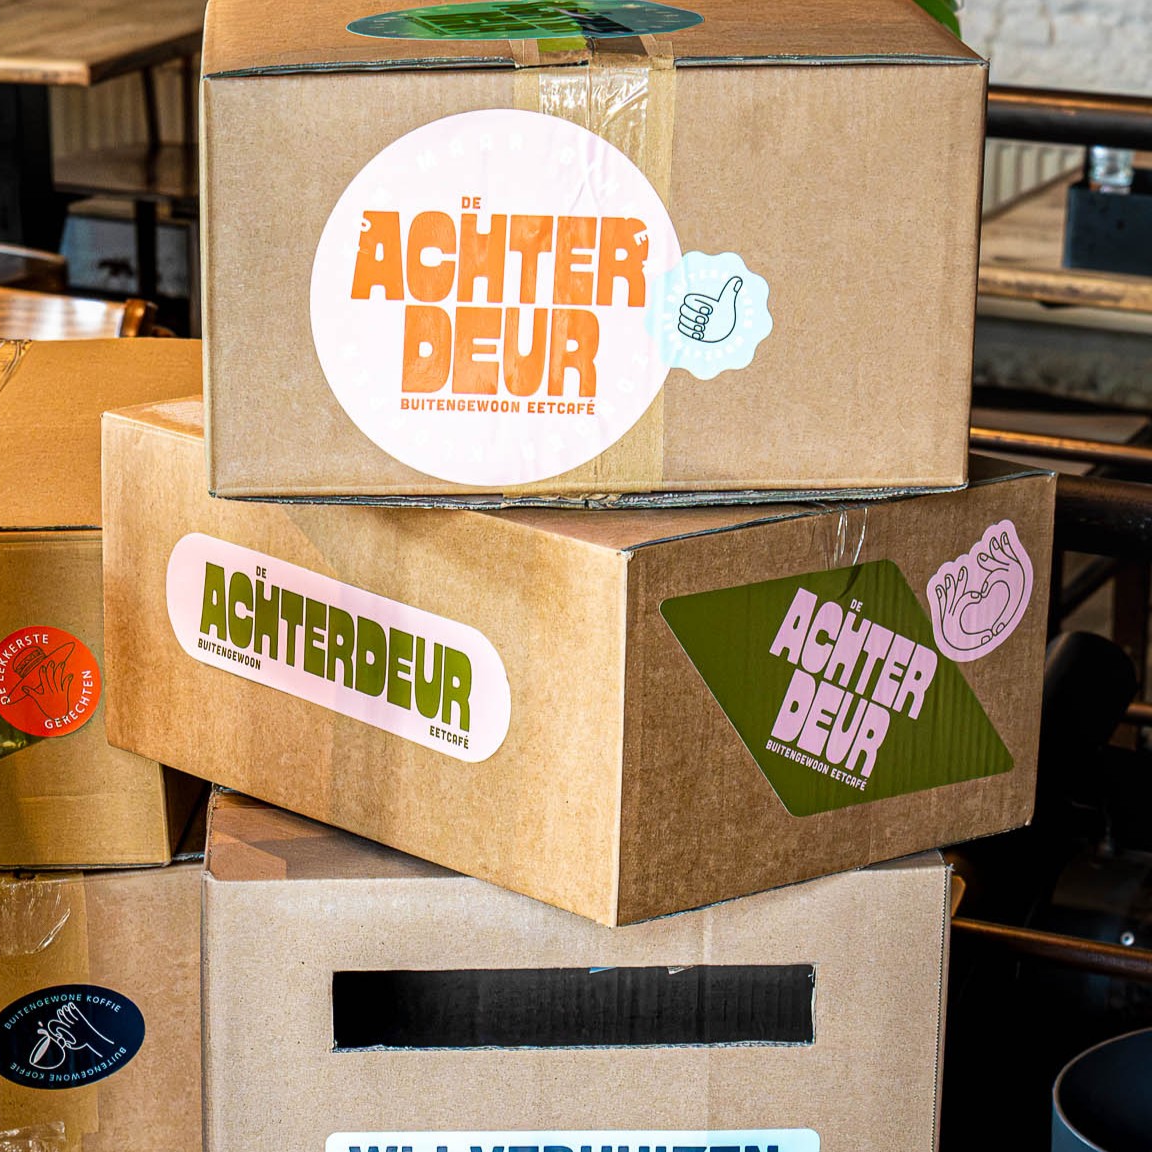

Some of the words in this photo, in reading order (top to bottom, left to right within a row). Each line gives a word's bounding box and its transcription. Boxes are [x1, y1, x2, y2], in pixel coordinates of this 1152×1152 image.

[461, 197, 482, 210] DE
[351, 211, 649, 307] ACHTER
[402, 305, 600, 398] DEUR
[400, 398, 520, 413] BUITENGEWOON
[527, 399, 595, 415] EETCAFÉ
[256, 565, 267, 579] DE
[850, 598, 863, 612] DE
[198, 637, 261, 670] BUITENGEWOON
[200, 562, 472, 732] ACHTERDEUR
[769, 587, 938, 720] ACHTER
[44, 670, 93, 729] GERECHTEN
[429, 725, 469, 749] EETCAFÉ
[771, 668, 890, 778] DEUR
[765, 739, 829, 774] BUITENGEWOON
[831, 768, 867, 791] EETCAFÉ
[4, 993, 82, 1030] BUITENGEWONE
[86, 995, 122, 1013] KOFFIE
[10, 1061, 45, 1080] KOFFIE
[49, 1046, 127, 1082] BUITENGEWONE
